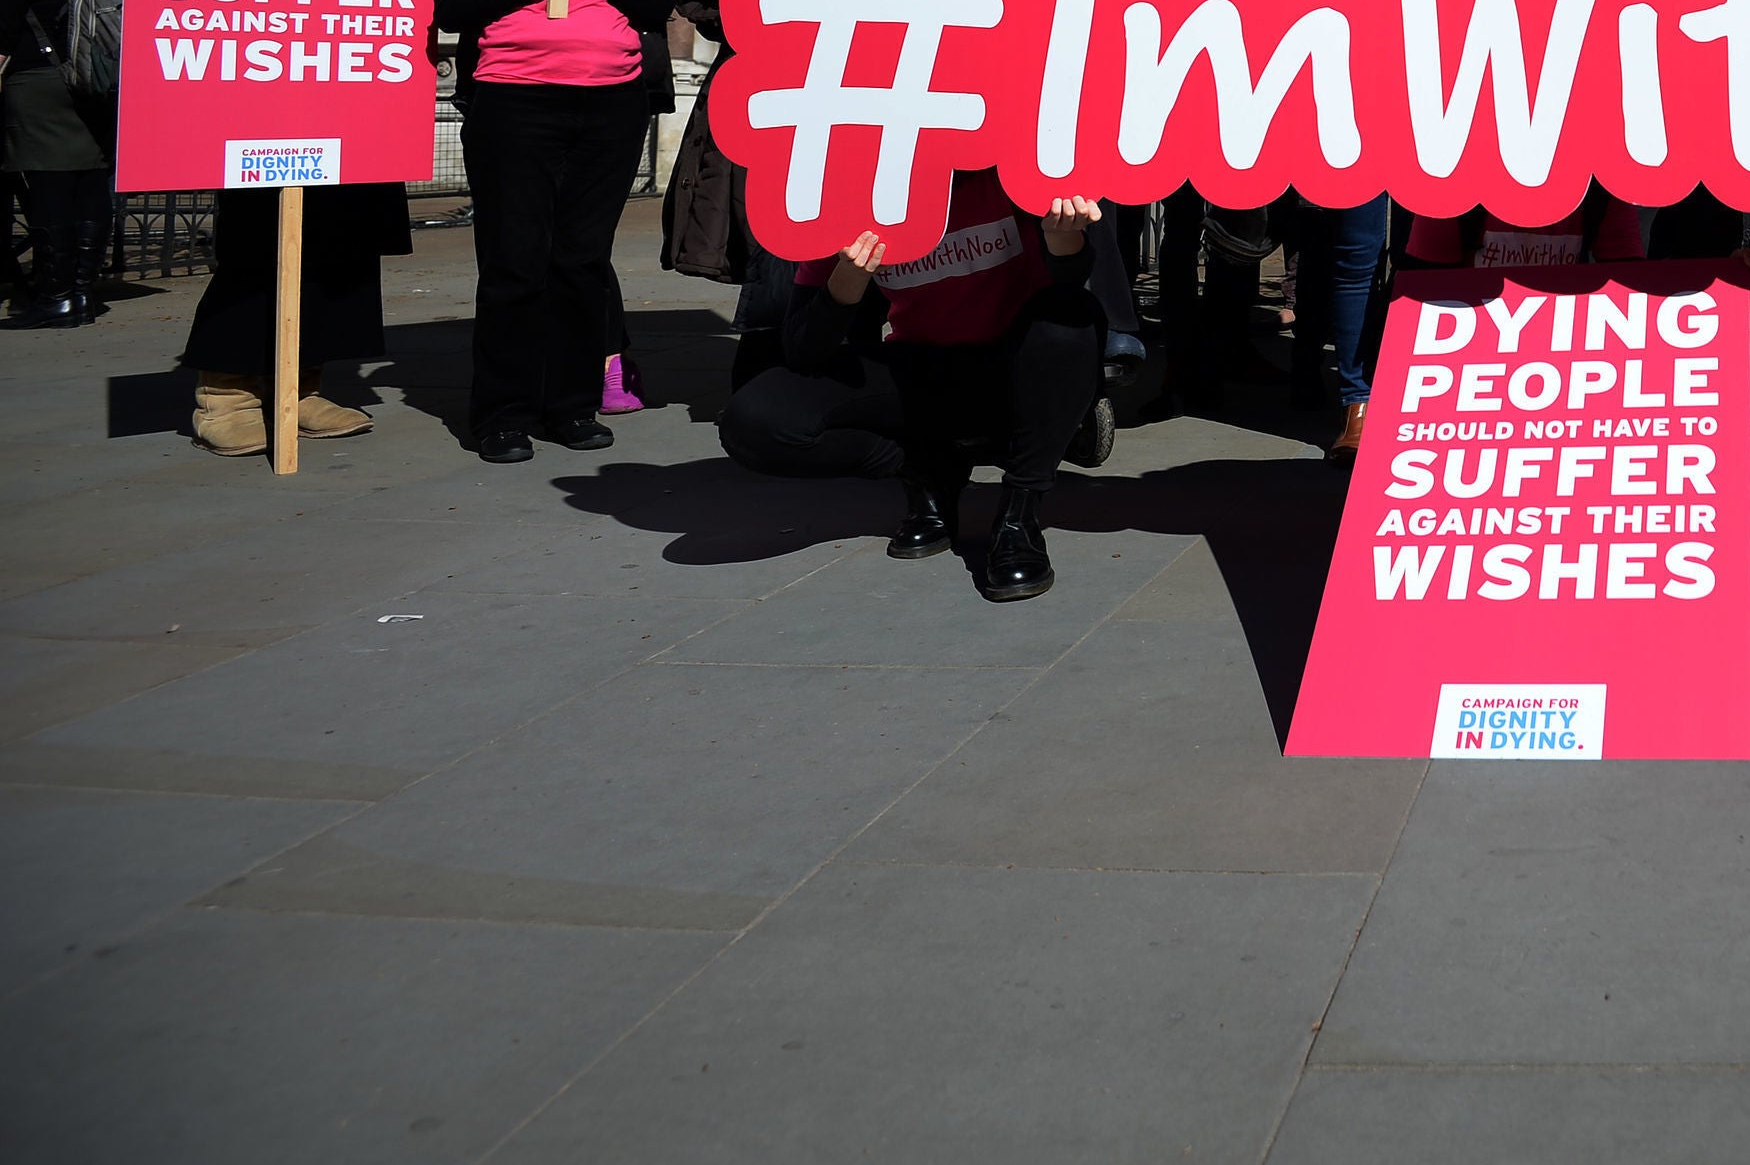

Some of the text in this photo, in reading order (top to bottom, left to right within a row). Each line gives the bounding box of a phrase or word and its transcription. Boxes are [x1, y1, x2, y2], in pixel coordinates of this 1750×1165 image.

[155, 8, 414, 36] AGAINST THEIR
[155, 38, 412, 82] WISHES
[242, 148, 299, 156] CAMPAIGN
[242, 156, 321, 168] DIGNITY
[241, 168, 328, 182] IN DYING.
[1413, 291, 1719, 355] DYING
[1401, 357, 1719, 412] PEOPLE
[1397, 417, 1718, 441] SHOULD NOT HAVE TO
[1384, 444, 1716, 499] SUFFER
[1376, 505, 1716, 536] AGAINST THEIR
[1374, 542, 1715, 600] WISHES
[1460, 698, 1578, 709] CAMPAIGN FOR
[1458, 711, 1575, 729] DIGNITY
[1454, 732, 1585, 751] IN DYING.
